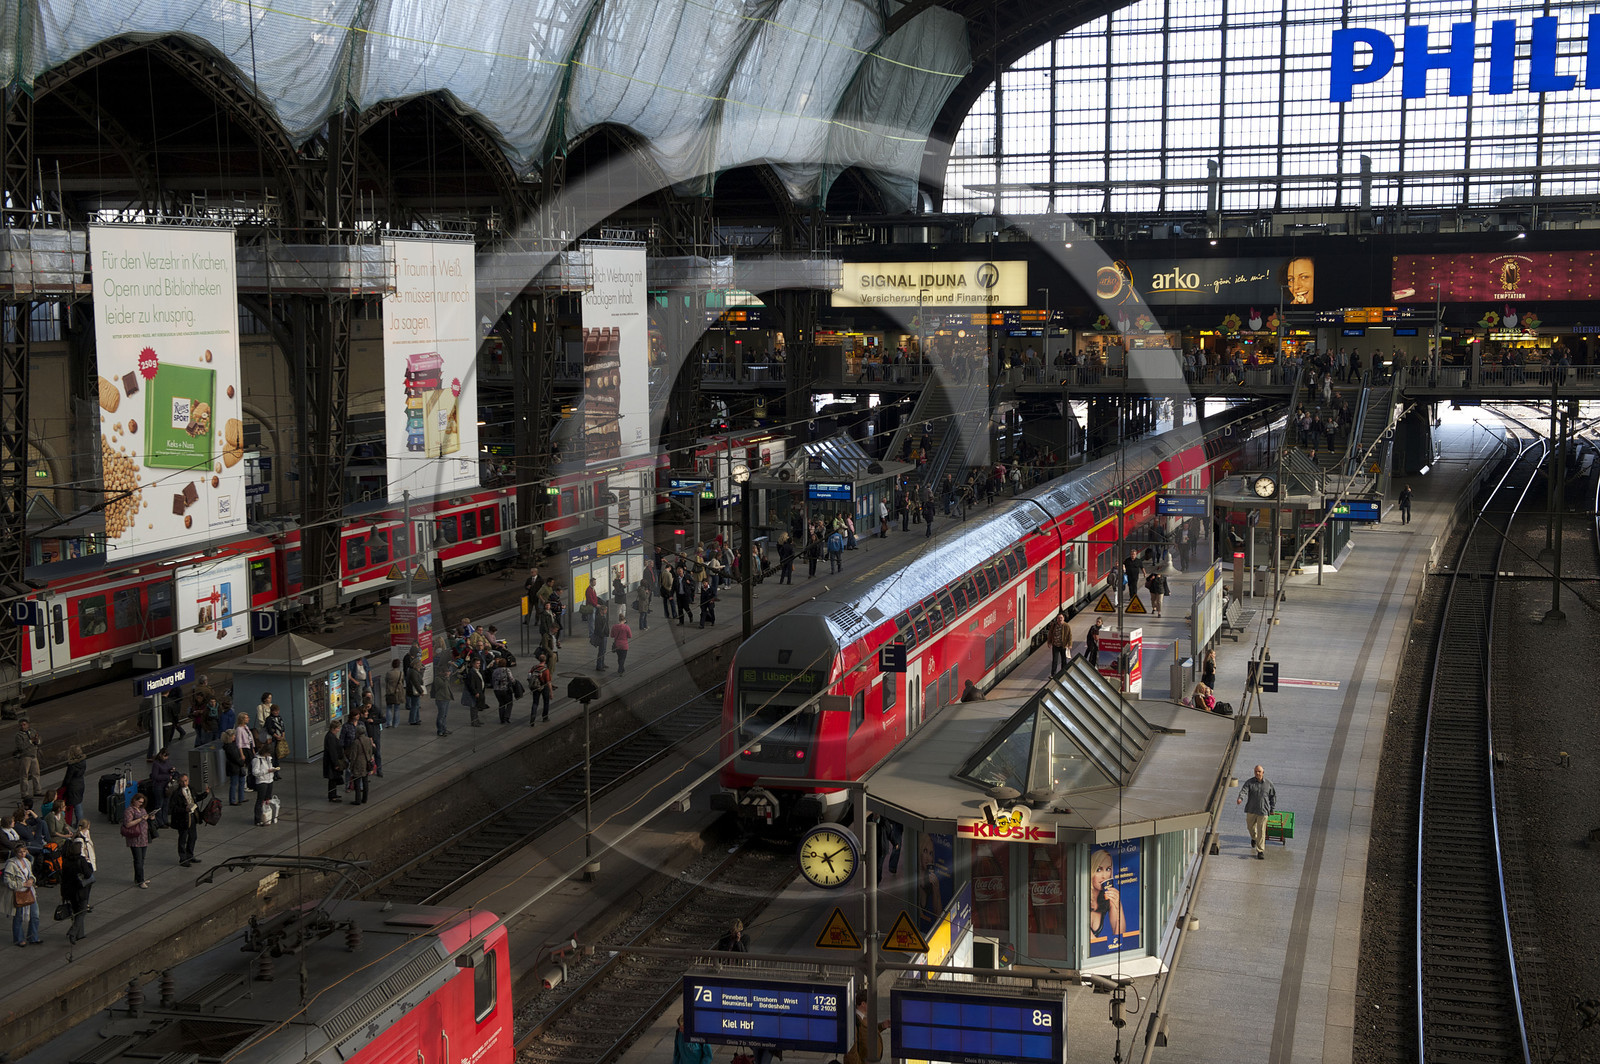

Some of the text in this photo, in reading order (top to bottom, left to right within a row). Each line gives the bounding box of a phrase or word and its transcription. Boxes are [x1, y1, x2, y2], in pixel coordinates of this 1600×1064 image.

[102, 249, 228, 273] Für den Verzehr in Kirchen,
[402, 258, 428, 277] Traum
[430, 261, 437, 277] in
[438, 257, 463, 277] Weiß.
[607, 267, 634, 288] Werbung
[635, 270, 643, 283] mit
[861, 274, 967, 288] SIGNAL IDUNA
[1152, 266, 1200, 290] arko
[103, 277, 221, 303] Opern und Bibliotheken
[405, 287, 435, 303] müssen
[437, 290, 449, 303] nur
[452, 284, 470, 303] noch
[586, 288, 617, 309] knackigem
[860, 292, 1000, 305] Versicherungen und Finanzen
[105, 303, 196, 328] leider zu knusprig.
[389, 312, 431, 336] Ja sagen.
[141, 360, 157, 370] 250g
[174, 414, 189, 422] SPORT
[808, 421, 816, 432] C
[925, 423, 932, 432] C
[1224, 427, 1232, 437] D
[1386, 429, 1393, 439] D
[167, 440, 178, 448] Keks
[16, 603, 29, 620] D
[258, 612, 272, 632] D
[882, 645, 895, 666] E
[147, 669, 186, 691] Hamburg Hbf
[1262, 663, 1274, 686] E
[973, 823, 1040, 840] KIOSK
[1126, 845, 1137, 853] Go
[1032, 883, 1062, 895] Coca-Cola
[694, 986, 713, 1002] 7a
[722, 994, 747, 1002] Pinneberg
[814, 996, 837, 1006] 17:20
[722, 1000, 753, 1008] Neumünster
[759, 1002, 790, 1010] Bordesholm
[722, 1019, 754, 1030] Kiel Hbf
[1032, 1009, 1052, 1027] 8a
